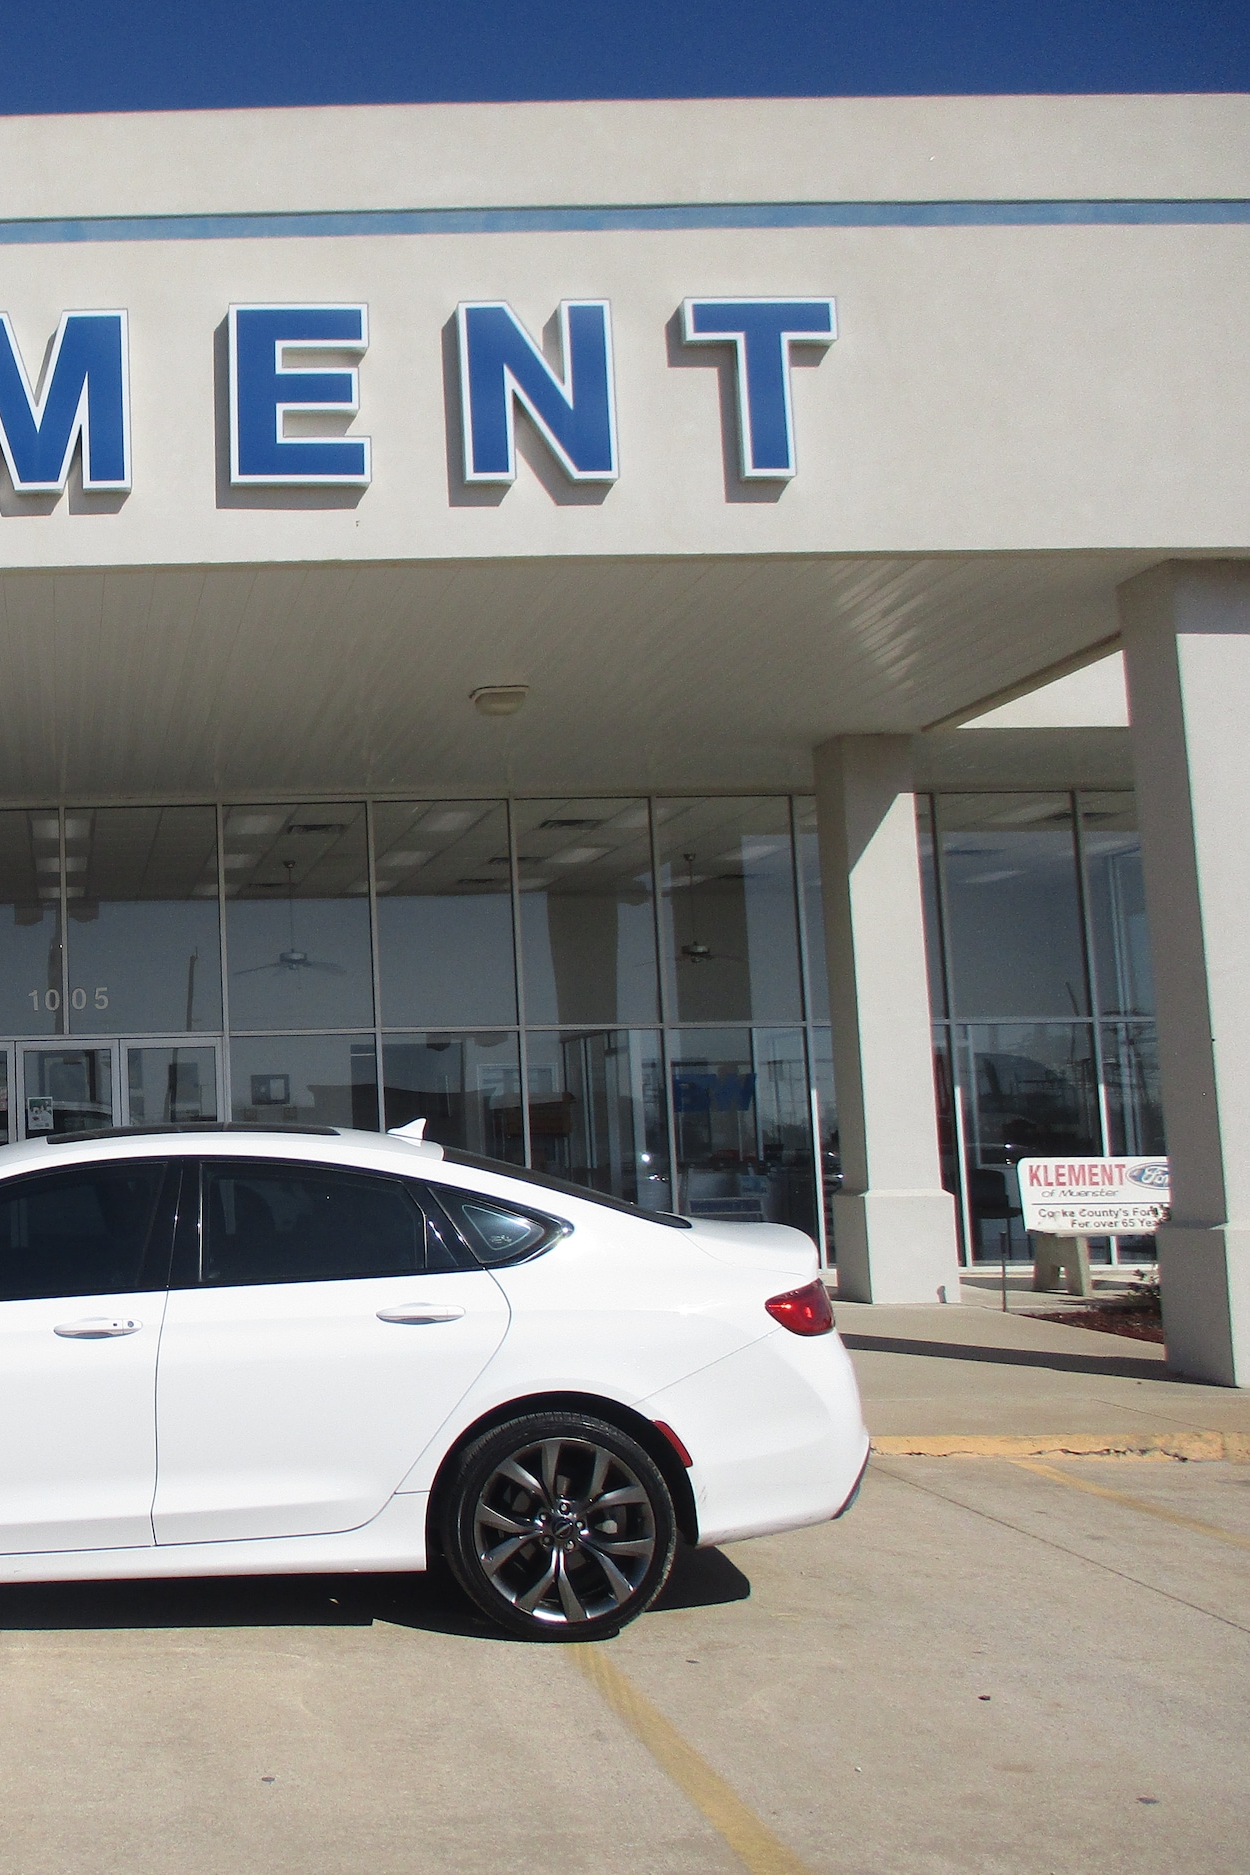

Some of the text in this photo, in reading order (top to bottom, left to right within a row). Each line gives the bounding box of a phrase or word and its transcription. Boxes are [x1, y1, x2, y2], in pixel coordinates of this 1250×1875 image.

[28, 986, 109, 1011] 1005
[1029, 1164, 1126, 1187] KLEMENT
[1041, 1187, 1119, 1198] of Muenster
[1078, 1207, 1129, 1219] County's
[1070, 1218, 1091, 1228] For
[1094, 1219, 1120, 1228] over
[1122, 1218, 1136, 1228] 65
